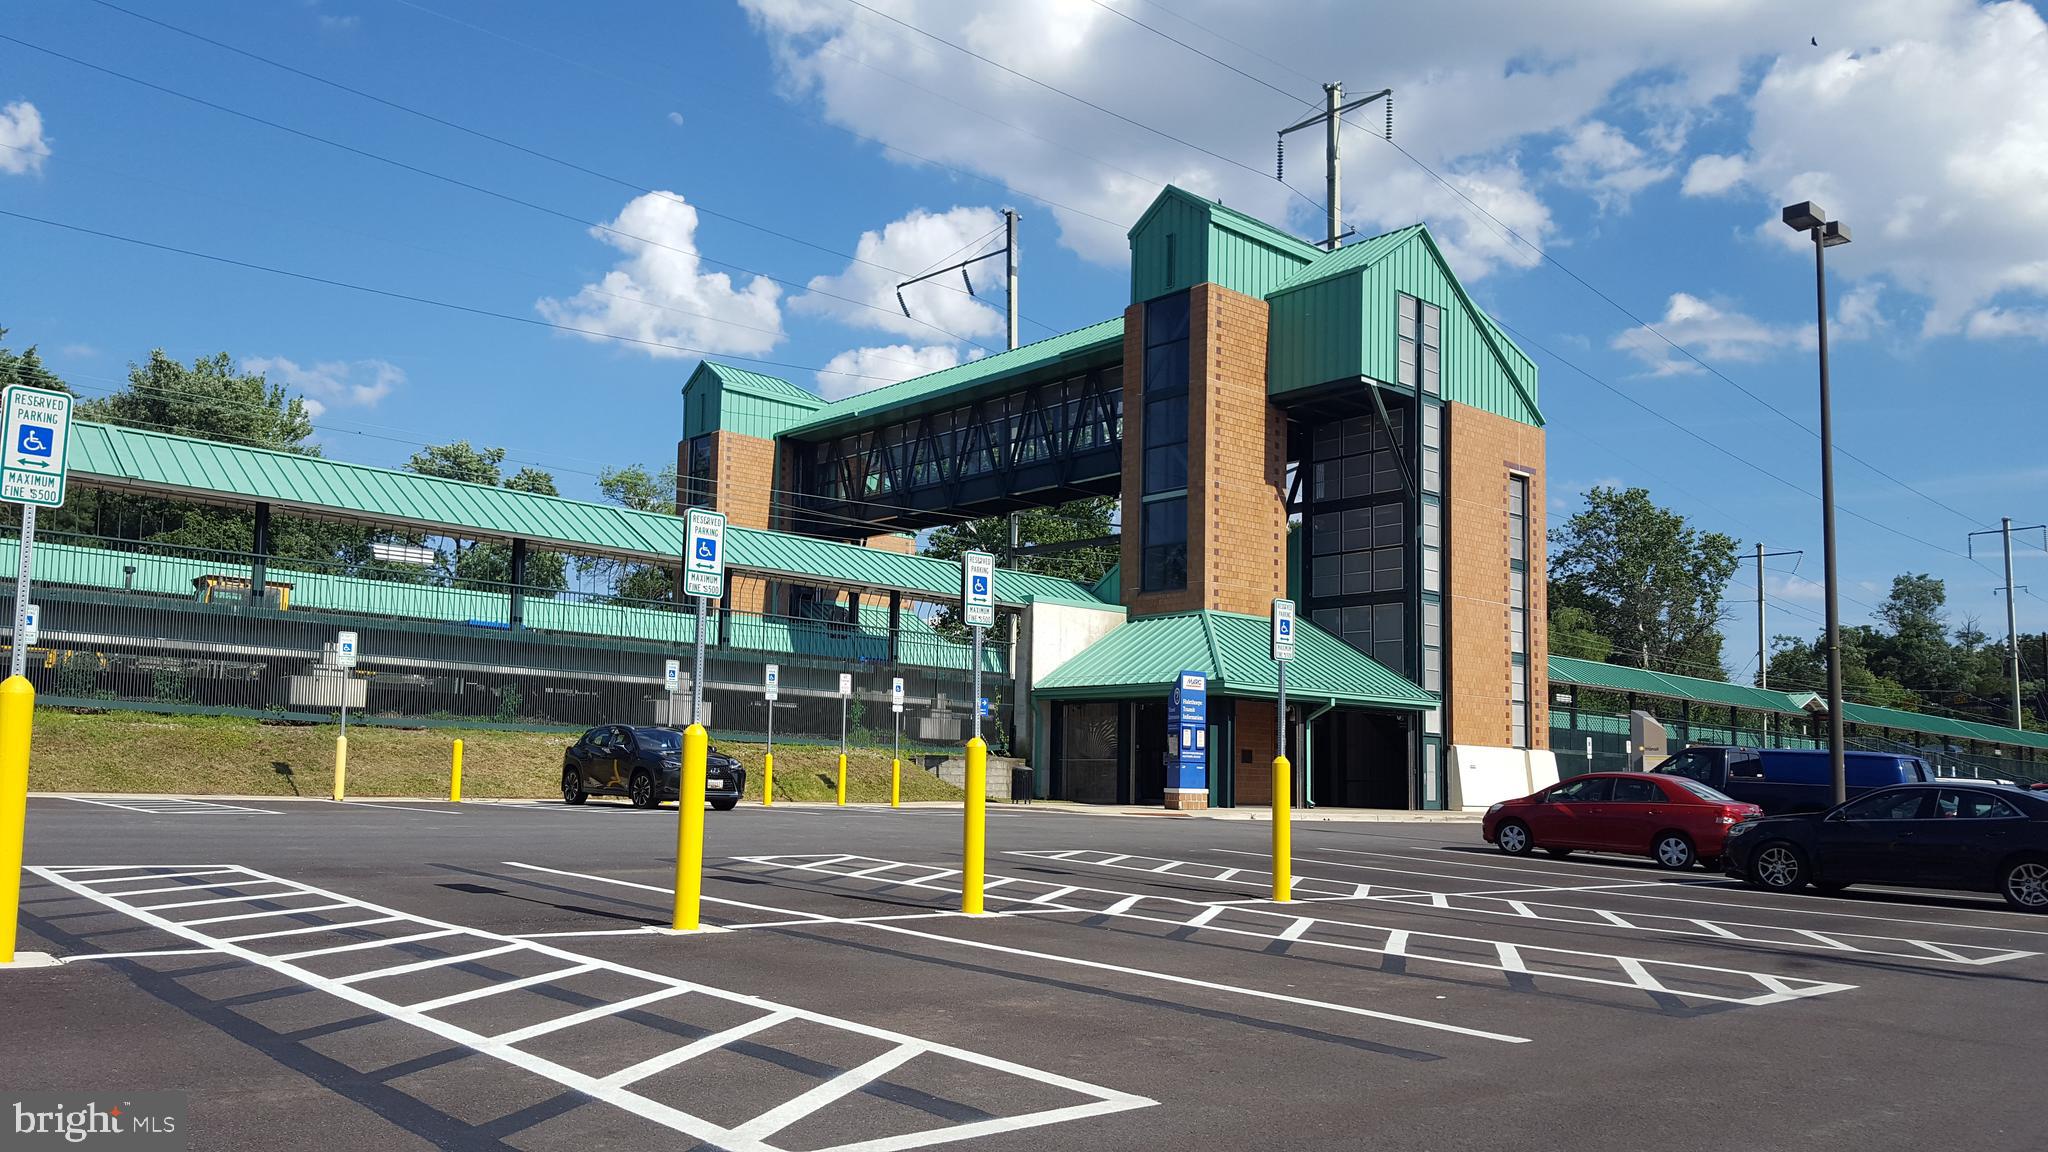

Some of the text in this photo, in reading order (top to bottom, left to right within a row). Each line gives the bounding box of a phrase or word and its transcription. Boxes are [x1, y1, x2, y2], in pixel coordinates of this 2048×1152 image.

[14, 393, 64, 411] RESERVED
[17, 408, 58, 424] PARKING
[8, 471, 55, 488] MAXIMUM
[4, 485, 57, 501] FINE $500
[692, 514, 722, 527] RESERVED
[694, 526, 719, 537] PARKING
[969, 555, 991, 566] RESERVED
[970, 565, 989, 575] PARKING
[690, 573, 718, 585] MAXIMUM
[688, 583, 720, 594] FINE $500
[969, 606, 990, 615] MAXIMUM
